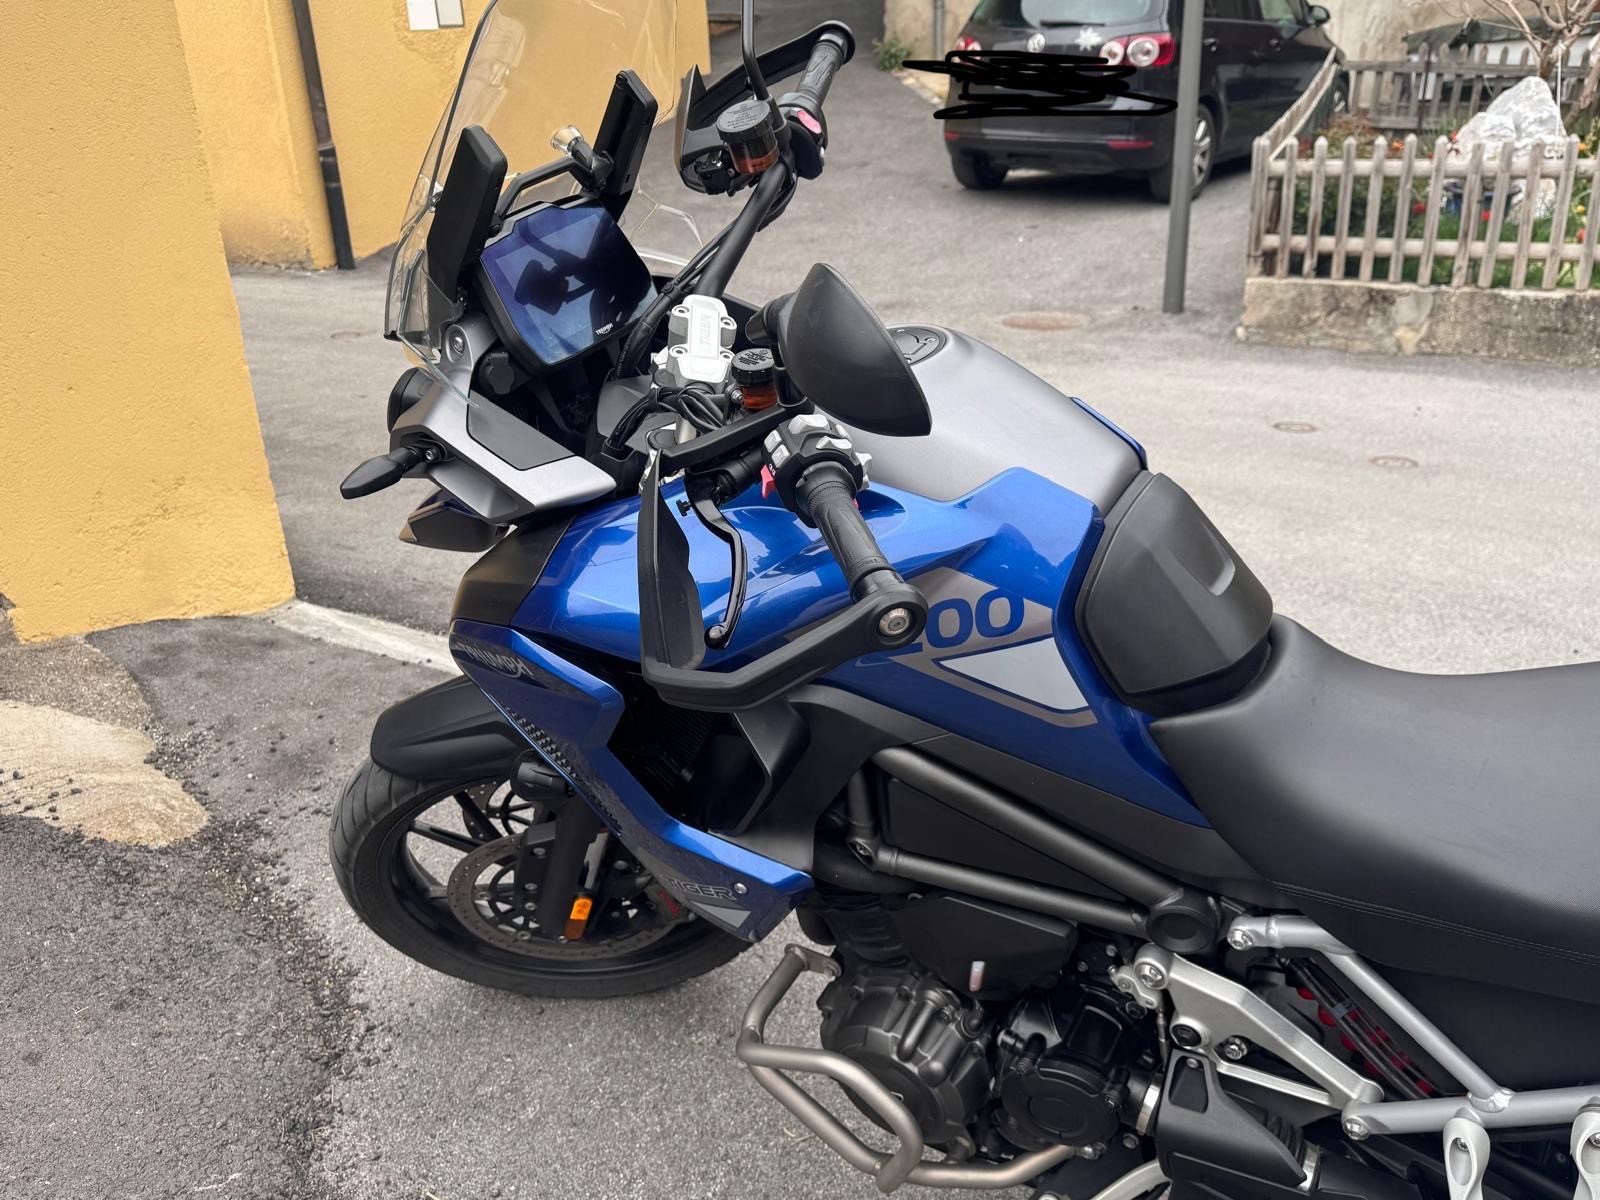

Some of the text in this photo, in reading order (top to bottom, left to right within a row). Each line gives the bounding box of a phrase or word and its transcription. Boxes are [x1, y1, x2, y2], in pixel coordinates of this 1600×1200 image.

[908, 587, 1025, 652] 00
[456, 642, 535, 680] TRIUMPH
[660, 874, 738, 902] TIGER
